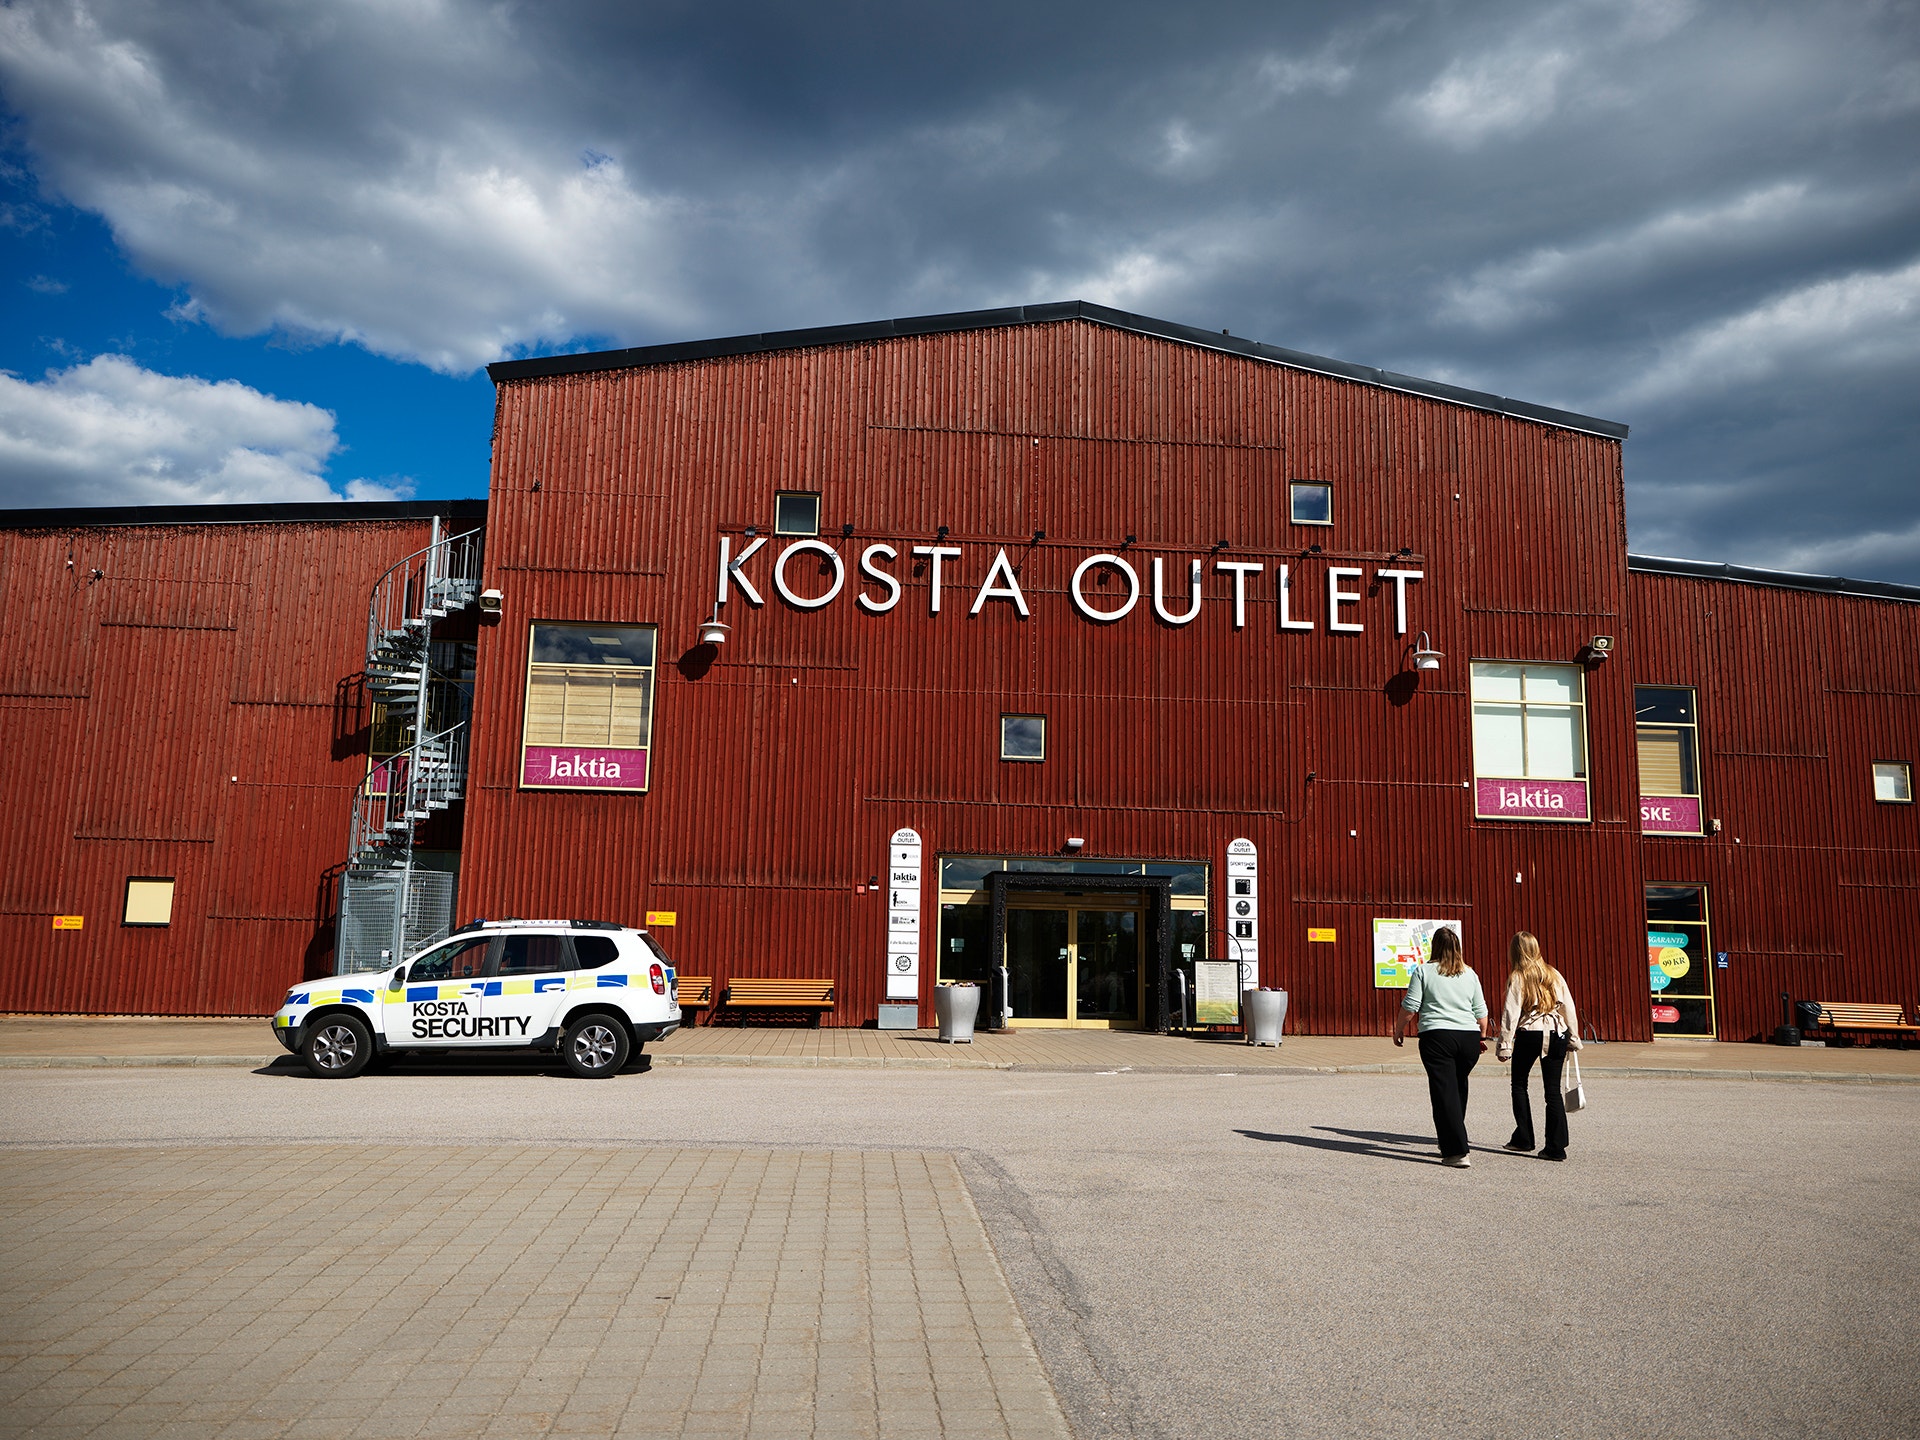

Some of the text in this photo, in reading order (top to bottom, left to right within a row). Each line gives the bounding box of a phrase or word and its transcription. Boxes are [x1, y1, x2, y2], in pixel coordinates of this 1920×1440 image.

[718, 536, 1424, 634] KOSTA OUTLET
[548, 754, 621, 779] Jaktia
[1499, 786, 1564, 810] Jaktia
[893, 872, 917, 881] Jaktia
[1662, 959, 1673, 968] 99
[1673, 957, 1686, 966] KR
[1653, 975, 1667, 984] KR
[413, 1002, 469, 1016] KOSTA
[412, 1016, 532, 1039] SECURITY
